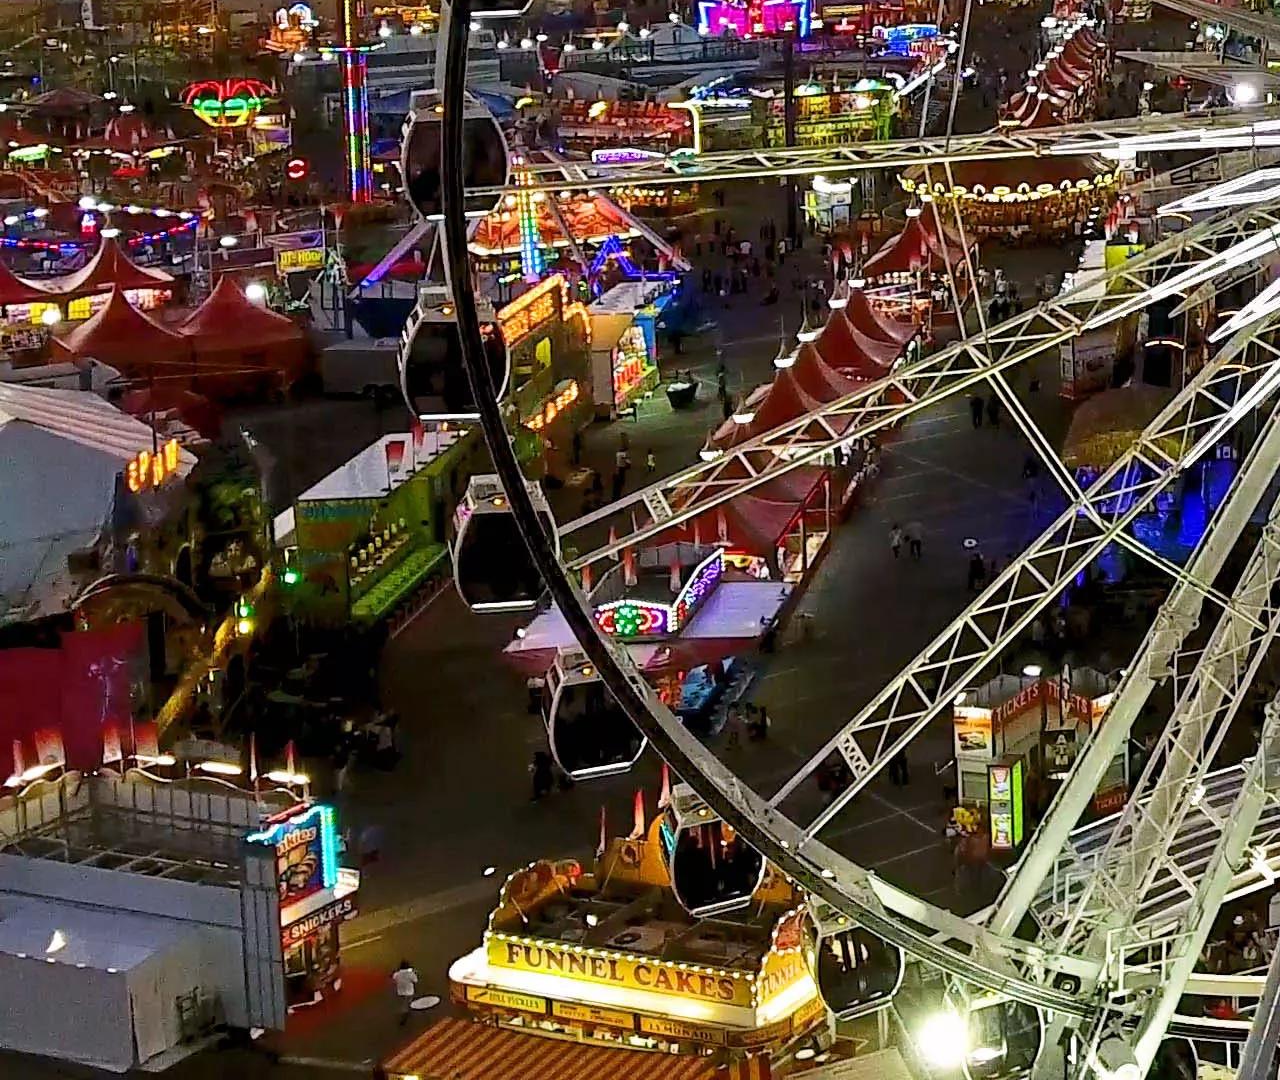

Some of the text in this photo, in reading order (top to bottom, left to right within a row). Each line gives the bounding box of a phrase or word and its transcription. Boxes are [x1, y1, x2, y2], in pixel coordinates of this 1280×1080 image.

[997, 683, 1040, 723] TICKETS
[1054, 733, 1070, 766] ATM
[290, 899, 352, 939] SNICKERS
[507, 942, 736, 1002] FUNNEL CAKES
